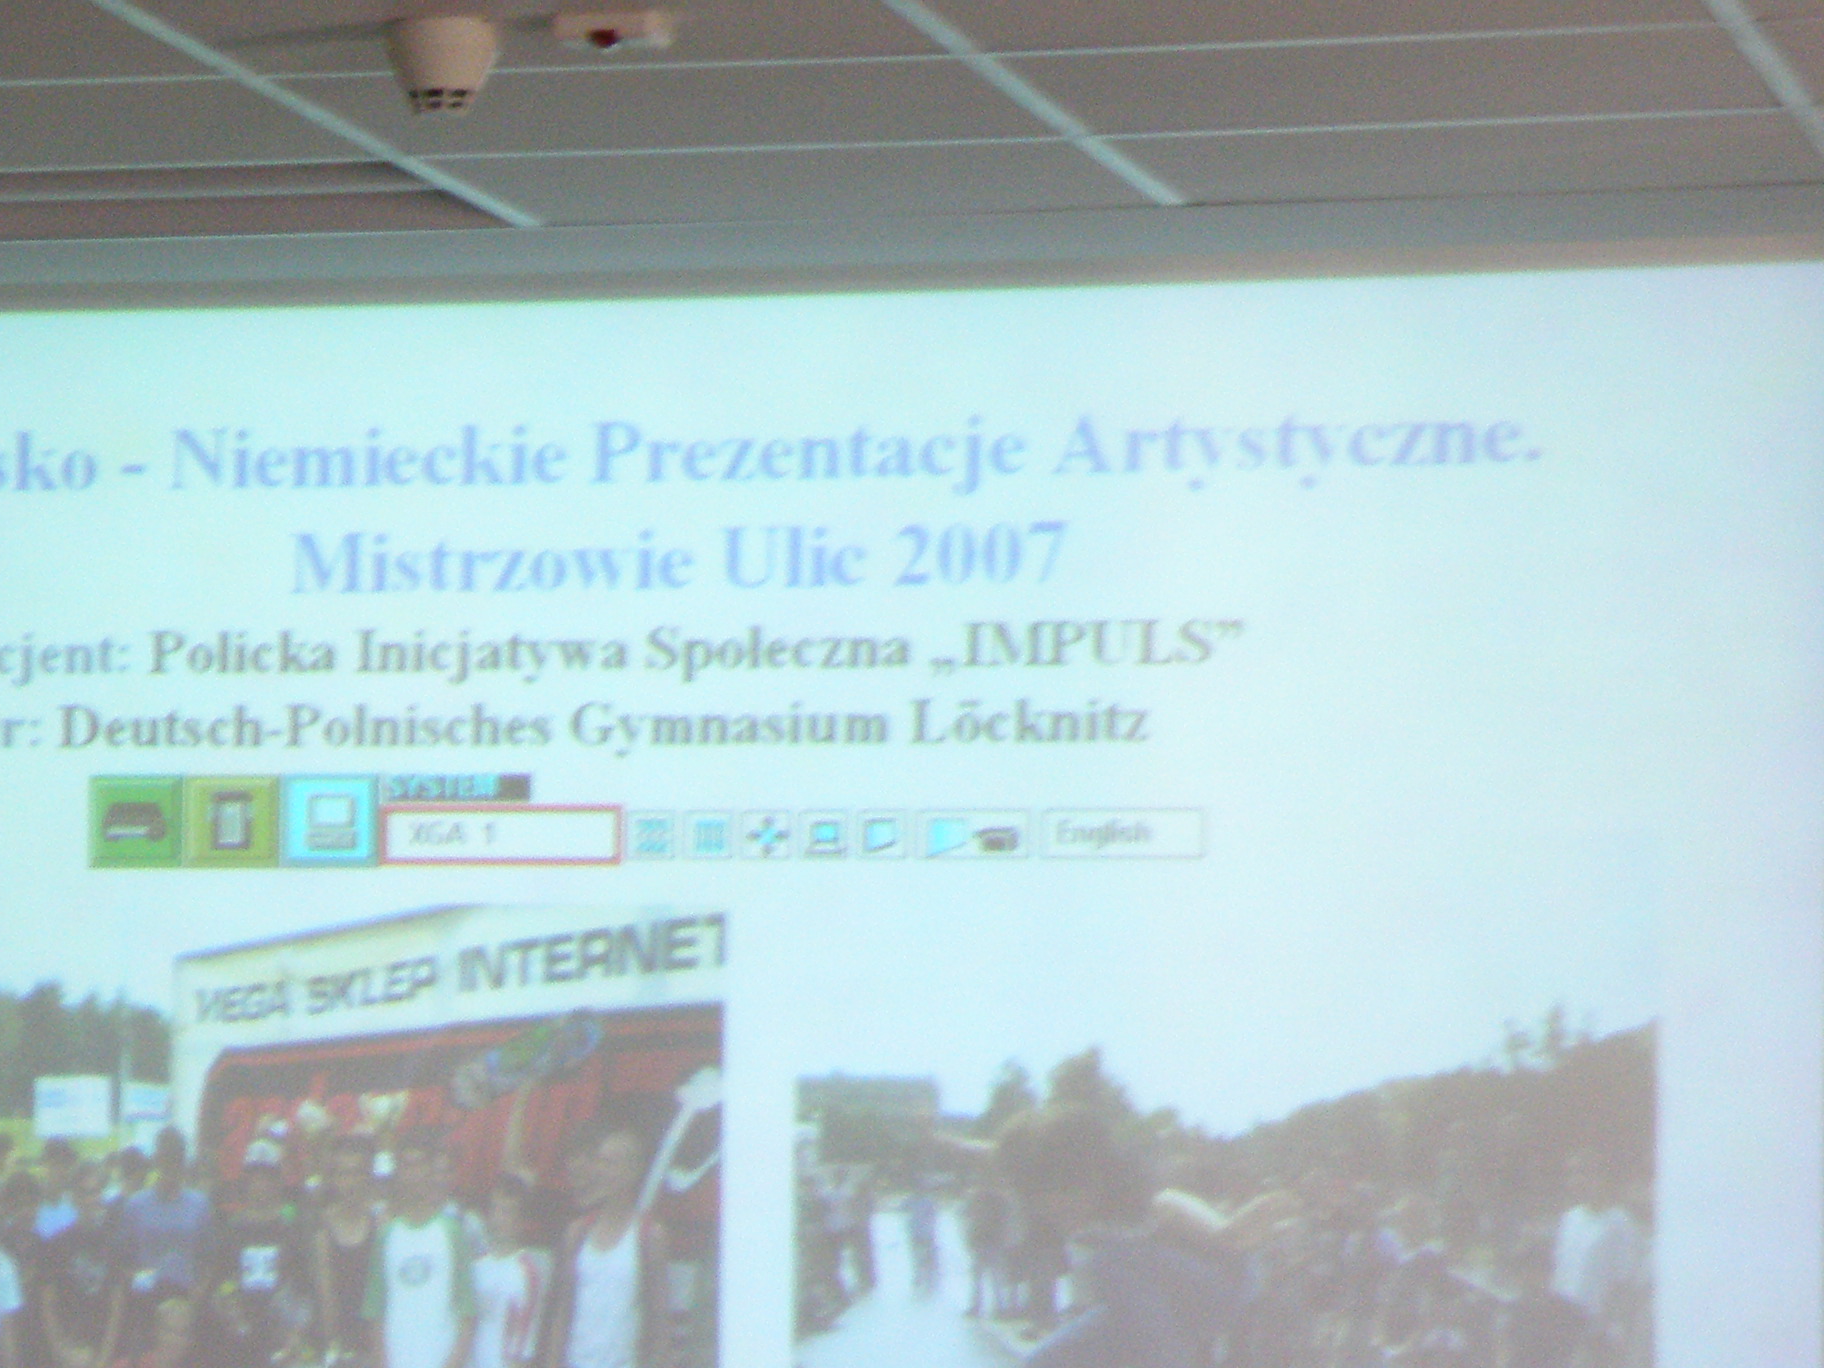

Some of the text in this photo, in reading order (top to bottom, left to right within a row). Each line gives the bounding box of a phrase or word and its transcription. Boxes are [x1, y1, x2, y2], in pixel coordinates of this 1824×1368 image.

[171, 422, 568, 490] Niemieckie
[590, 415, 1028, 495] Prezentacje
[1052, 413, 1544, 492] Artystyczne.
[291, 520, 1068, 595] Mistrzowie Ulic 2007
[150, 630, 336, 676] Policka
[354, 626, 629, 684] Inicjatywa
[56, 700, 552, 750] Deutsch-Polnisches
[568, 701, 890, 758] Gymnasium
[1056, 818, 1153, 850] English
[306, 955, 439, 1018] SKLEP
